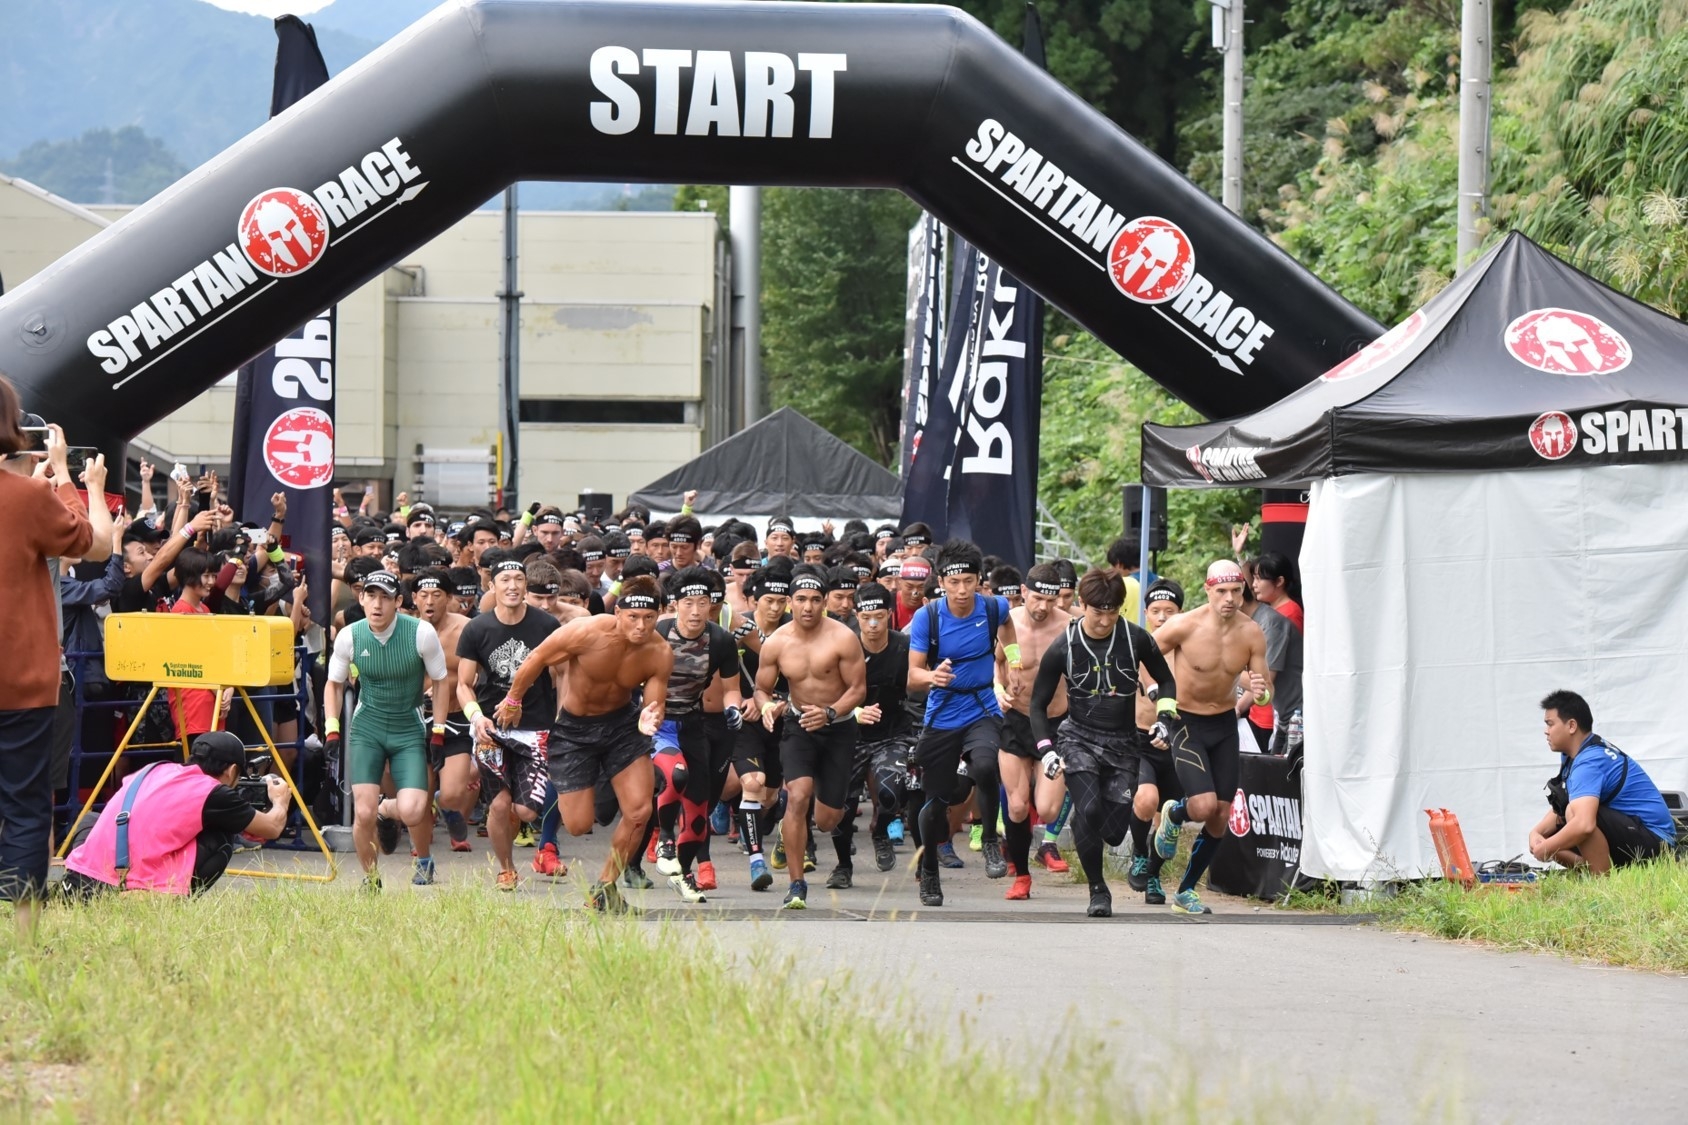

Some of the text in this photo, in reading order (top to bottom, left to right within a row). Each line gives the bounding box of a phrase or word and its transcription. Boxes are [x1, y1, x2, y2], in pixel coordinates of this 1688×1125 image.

[590, 46, 847, 139] START
[86, 136, 422, 375] SPARTAN RACE
[964, 119, 1275, 365] SPARTAN RACE
[631, 595, 655, 603] SPARTAN
[1248, 793, 1302, 840] SPARTAN
